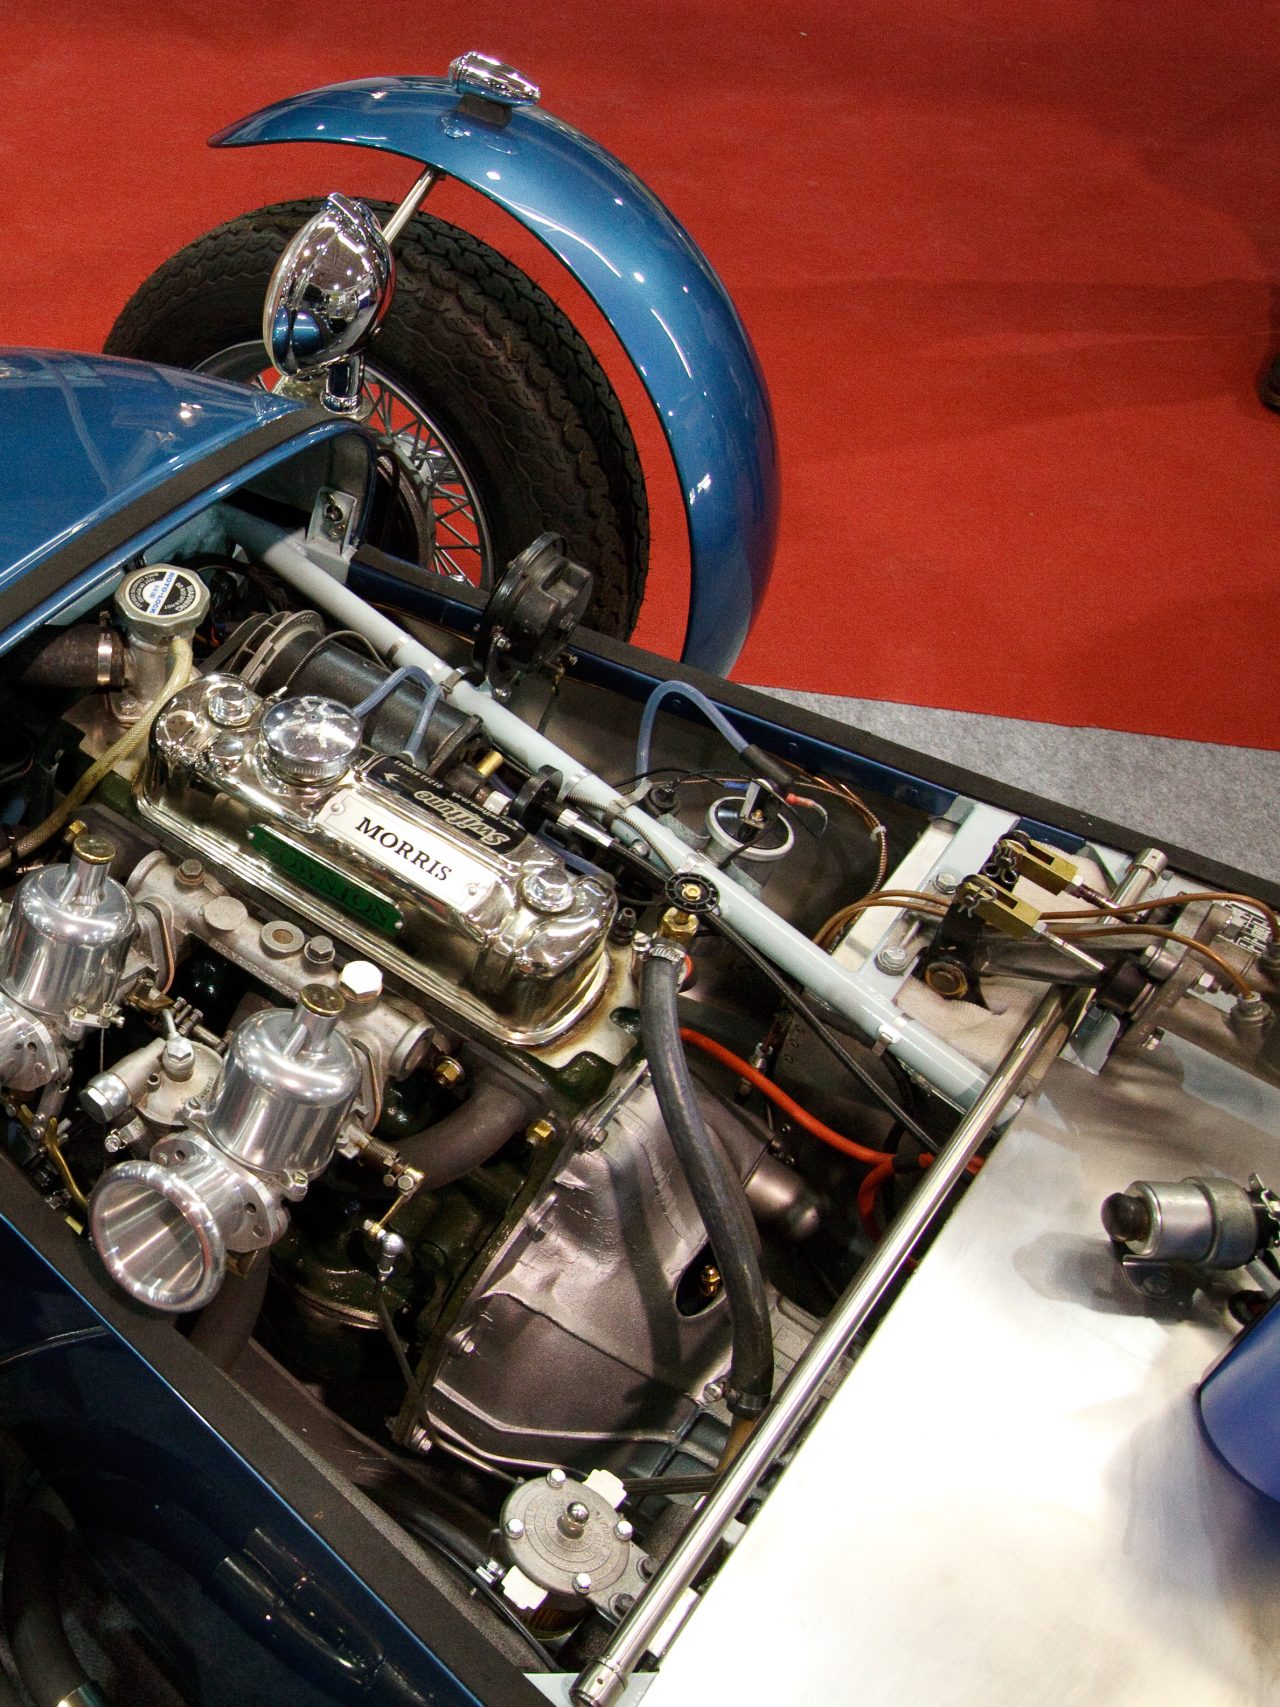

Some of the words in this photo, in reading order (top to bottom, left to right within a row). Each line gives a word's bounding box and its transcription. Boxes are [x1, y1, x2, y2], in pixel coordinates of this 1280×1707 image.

[175, 585, 195, 612] WARNING
[414, 791, 510, 845] Swiftune
[355, 816, 452, 881] MORRIS
[265, 844, 391, 926] OWNTON
